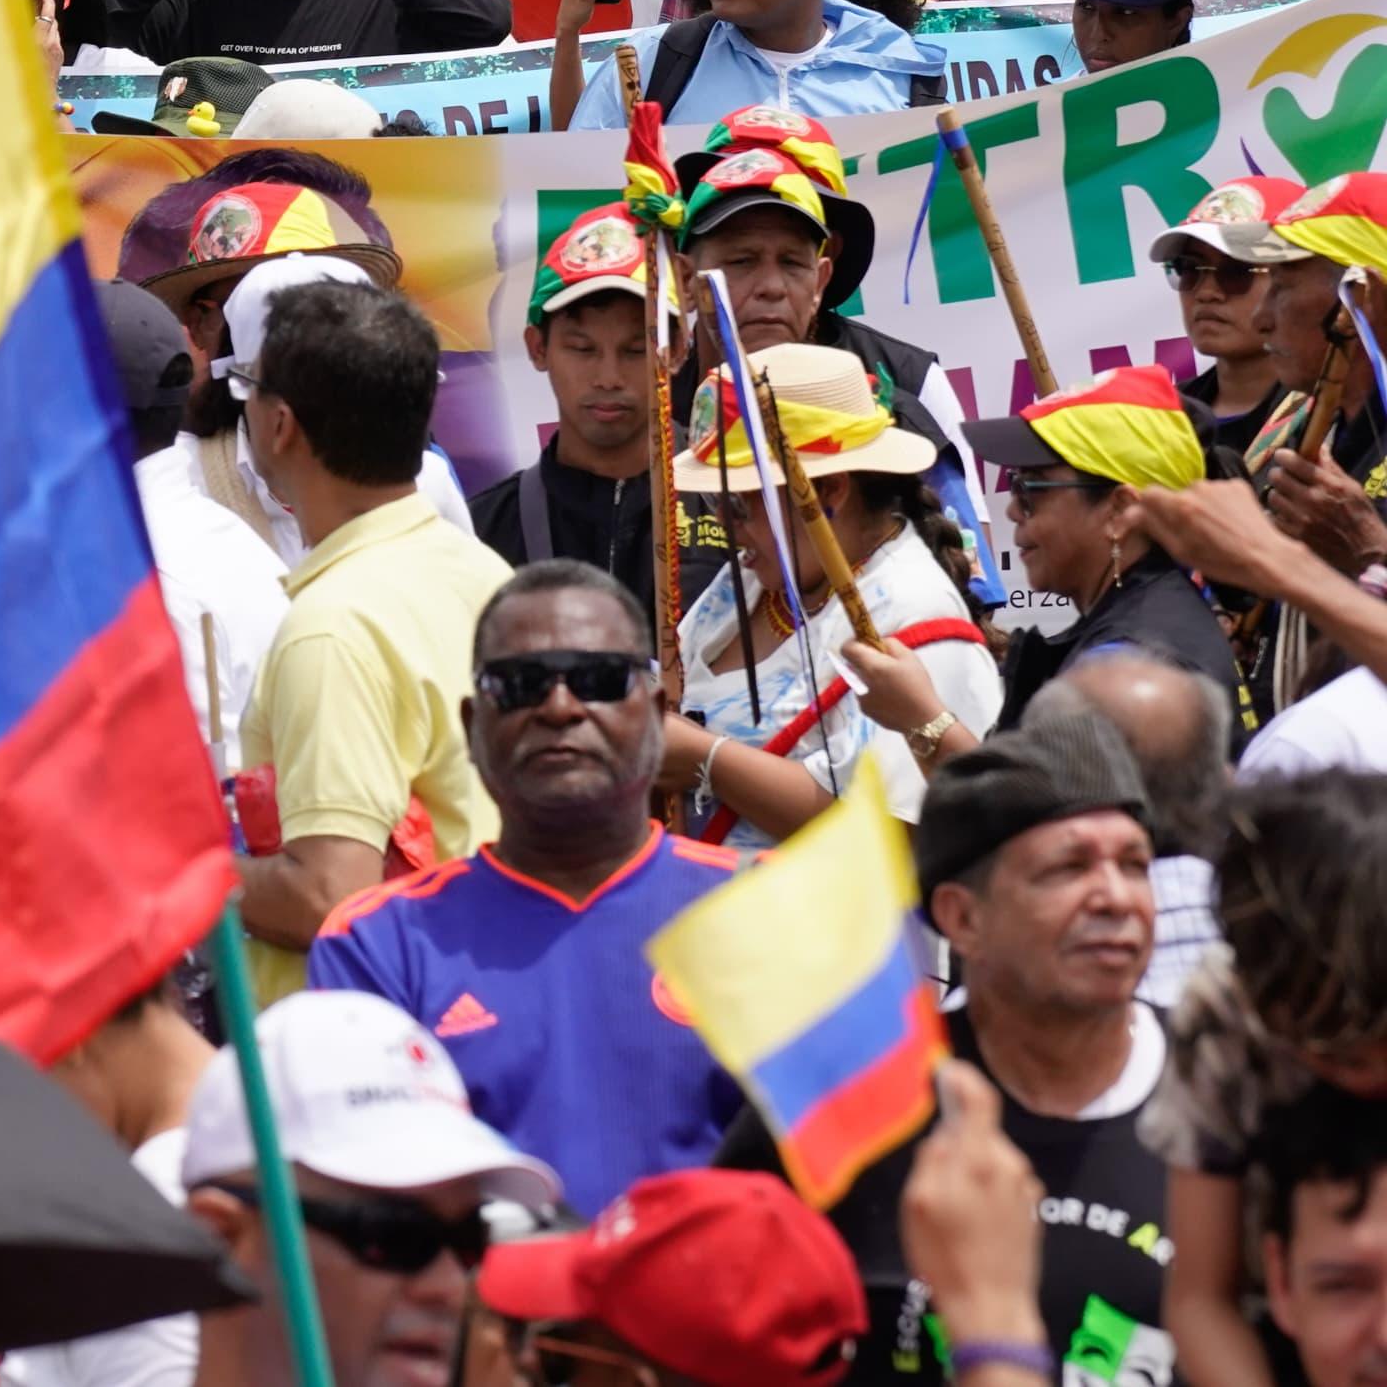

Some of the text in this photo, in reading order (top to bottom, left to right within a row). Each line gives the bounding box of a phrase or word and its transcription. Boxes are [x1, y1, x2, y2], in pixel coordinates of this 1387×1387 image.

[220, 43, 342, 55] GET OVER YOUR FEAR OF HEIGHTS
